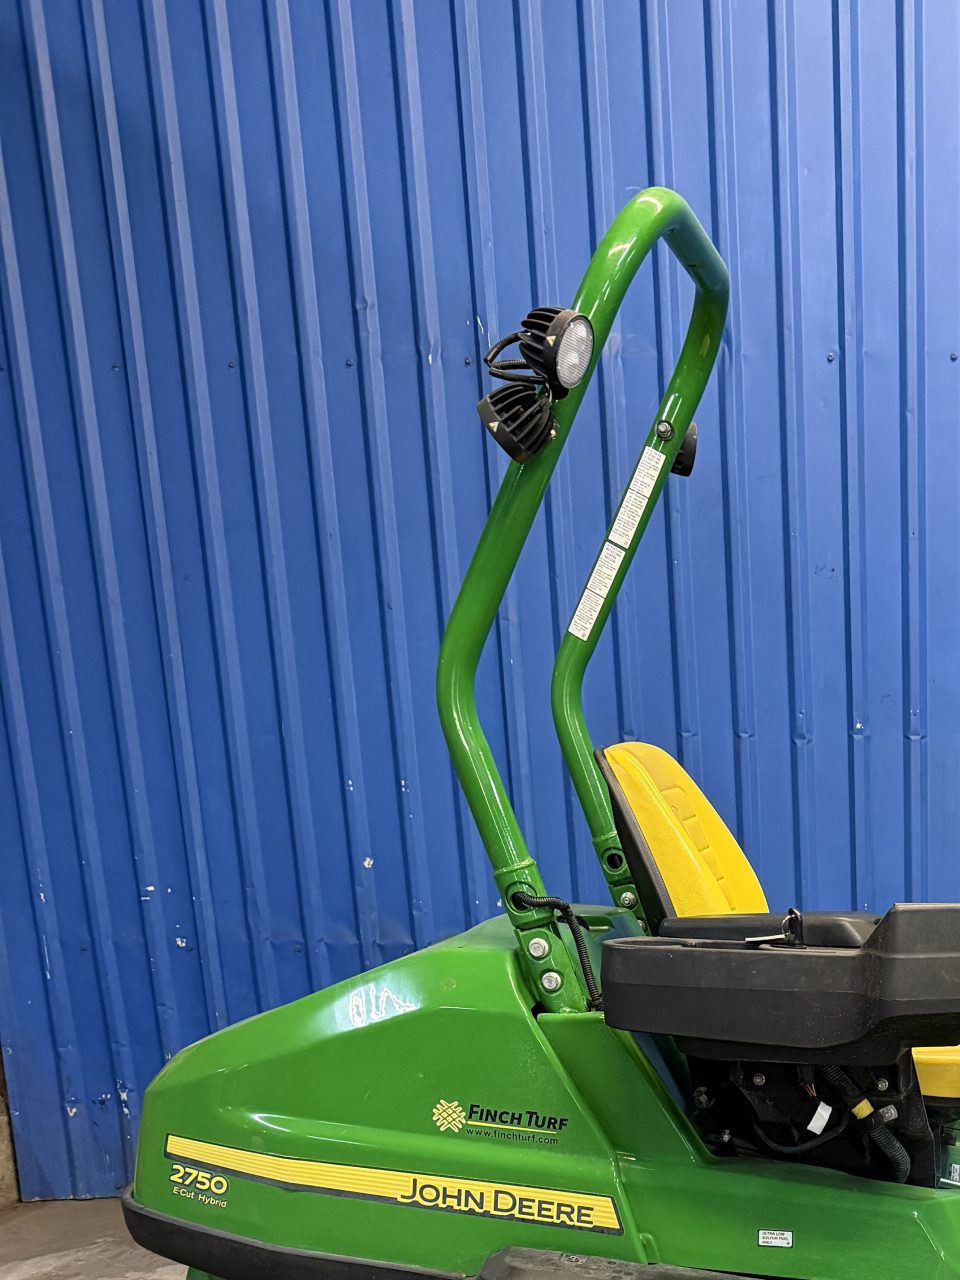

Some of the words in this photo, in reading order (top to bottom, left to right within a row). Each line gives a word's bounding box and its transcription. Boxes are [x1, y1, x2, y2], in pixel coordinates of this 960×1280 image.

[468, 1104, 522, 1125] FINCH
[525, 1111, 568, 1130] TURF
[466, 1128, 558, 1144] www.finchturf.com
[170, 1164, 228, 1195] 2750
[198, 1193, 227, 1208] Hybrid
[401, 1178, 484, 1209] JOHN
[493, 1189, 594, 1225] DEERE
